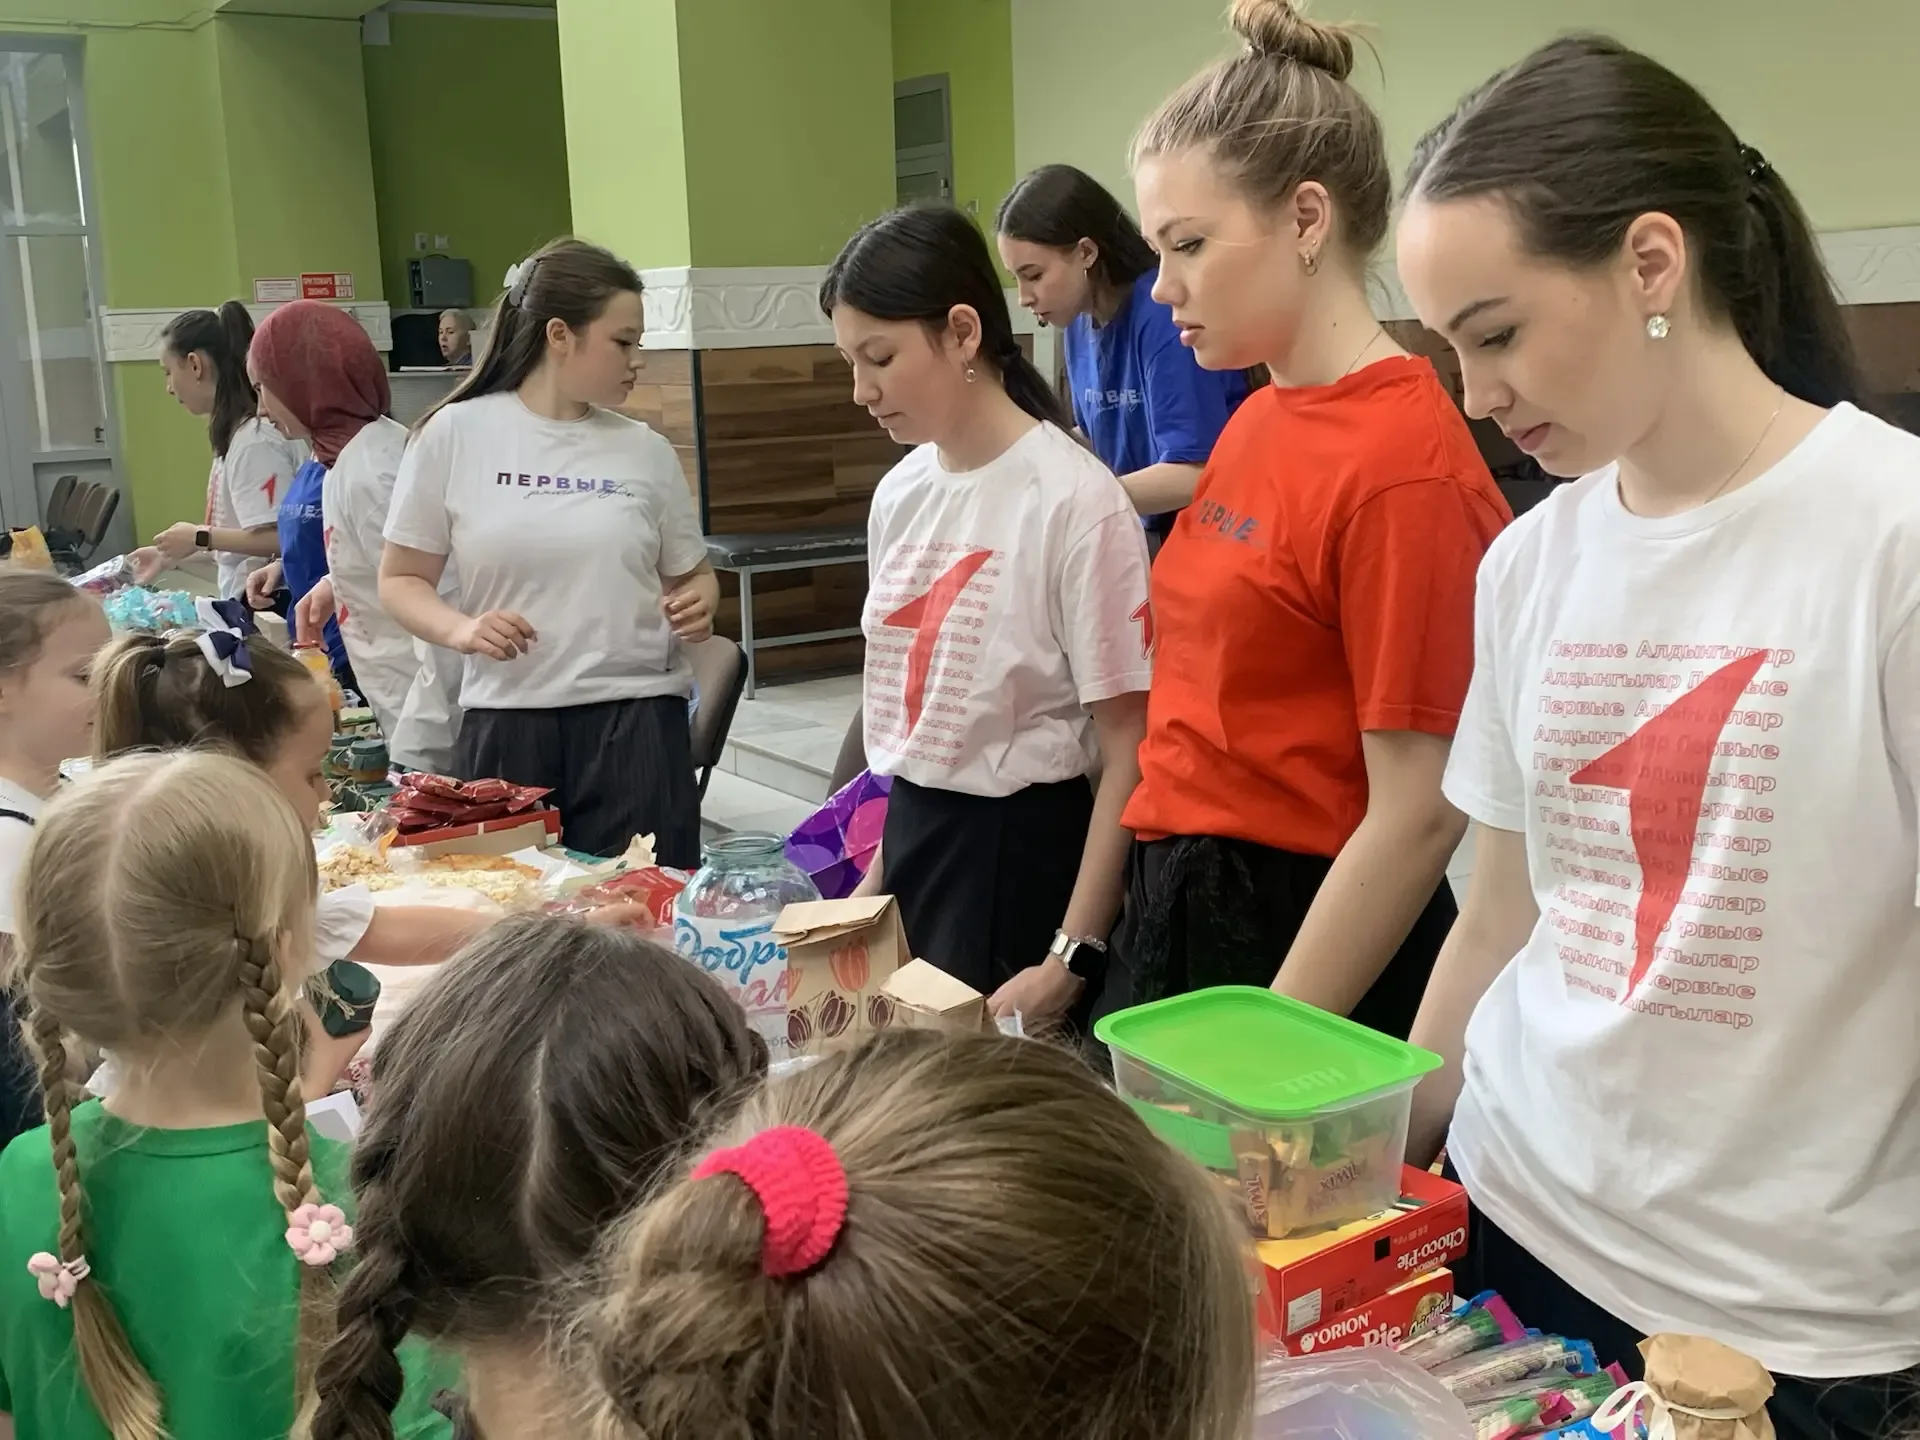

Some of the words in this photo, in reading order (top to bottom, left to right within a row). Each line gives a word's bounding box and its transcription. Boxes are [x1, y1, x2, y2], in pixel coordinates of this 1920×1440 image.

[496, 472, 615, 492] ПЕРВЫЕ
[1548, 639, 1629, 660] Первые
[1541, 667, 1682, 692] Алдынгылар
[1687, 671, 1789, 697] Пые
[1537, 695, 1626, 718] Первые
[1546, 907, 1625, 945] Первые
[1649, 968, 1757, 999] ервые
[1318, 1313, 1370, 1345] ORION
[1409, 1292, 1453, 1337] Original
